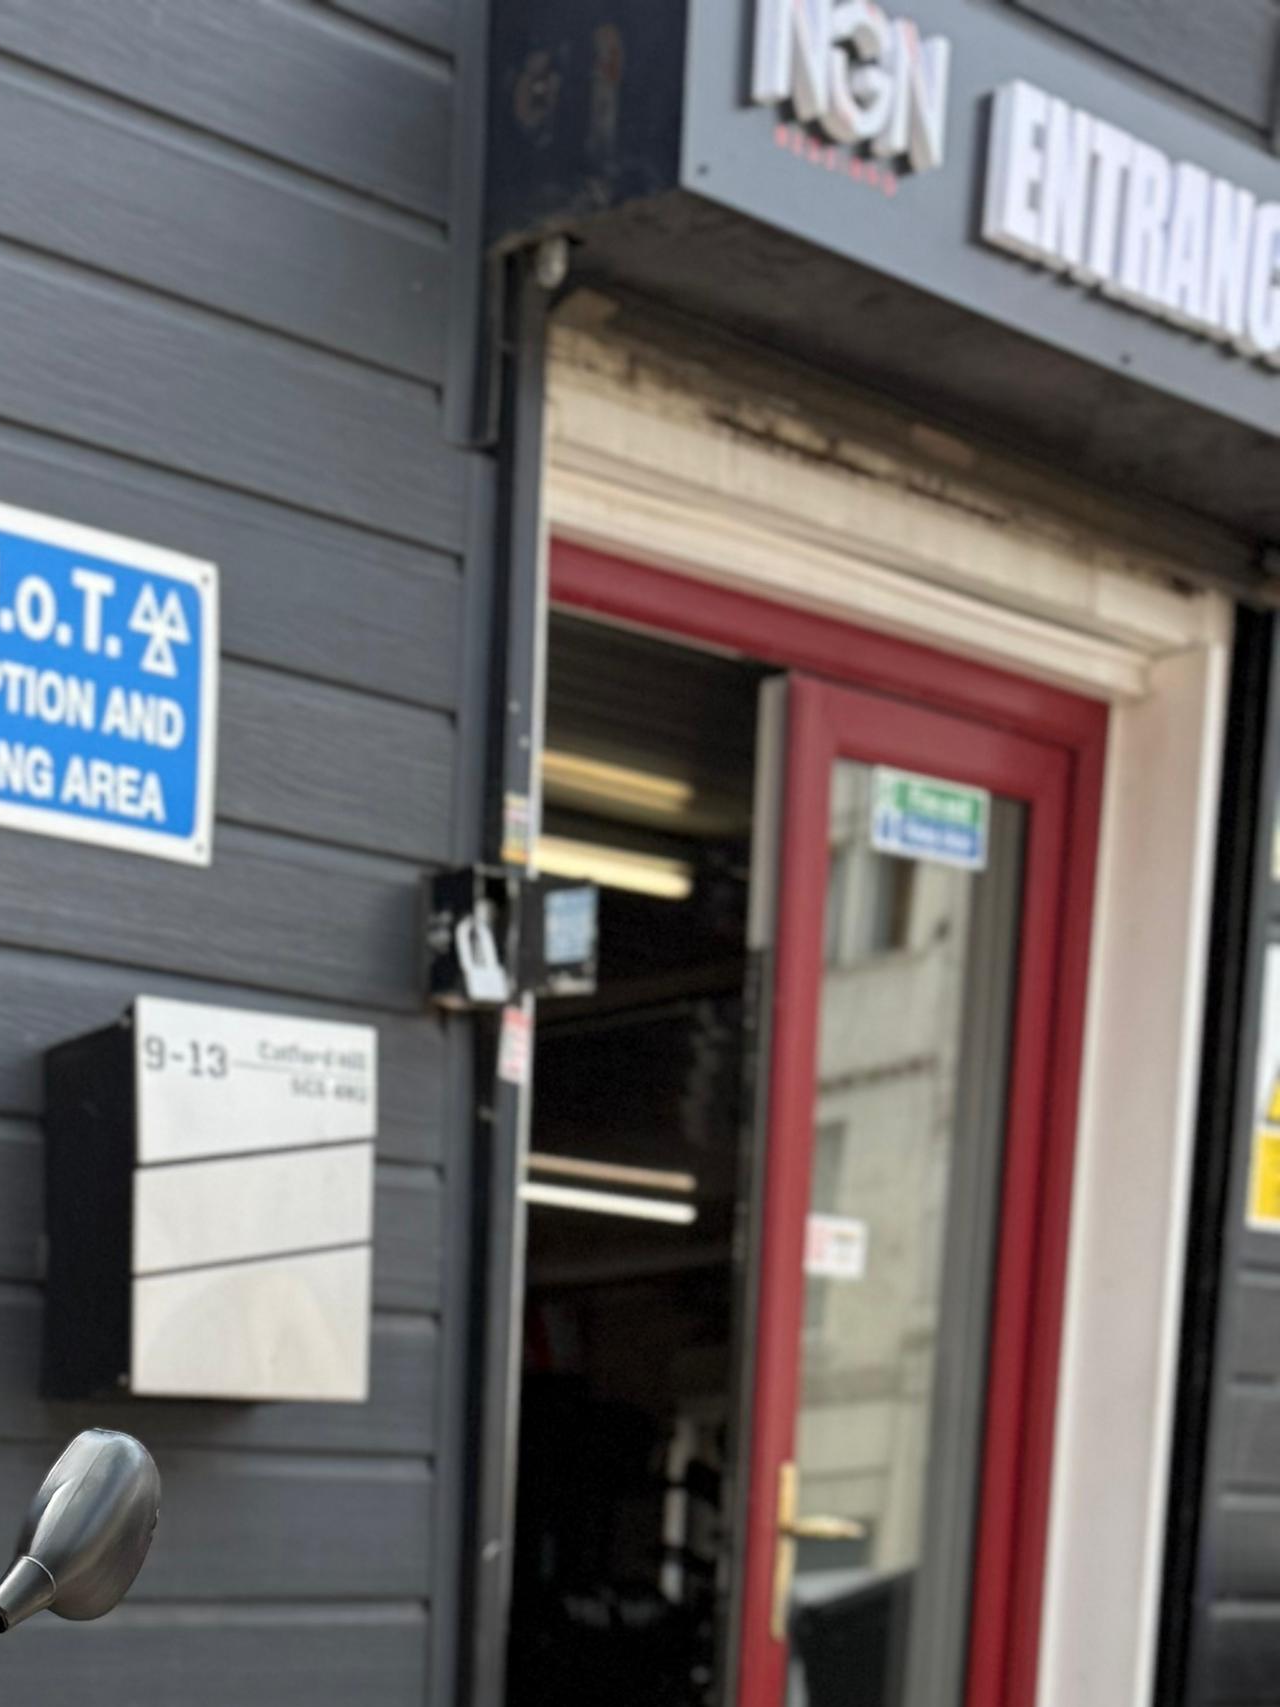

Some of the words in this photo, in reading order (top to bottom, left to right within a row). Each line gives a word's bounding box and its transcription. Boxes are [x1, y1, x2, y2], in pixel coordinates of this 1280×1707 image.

[103, 688, 184, 751] AND
[61, 754, 167, 824] AREA
[143, 1035, 228, 1078] 9-13
